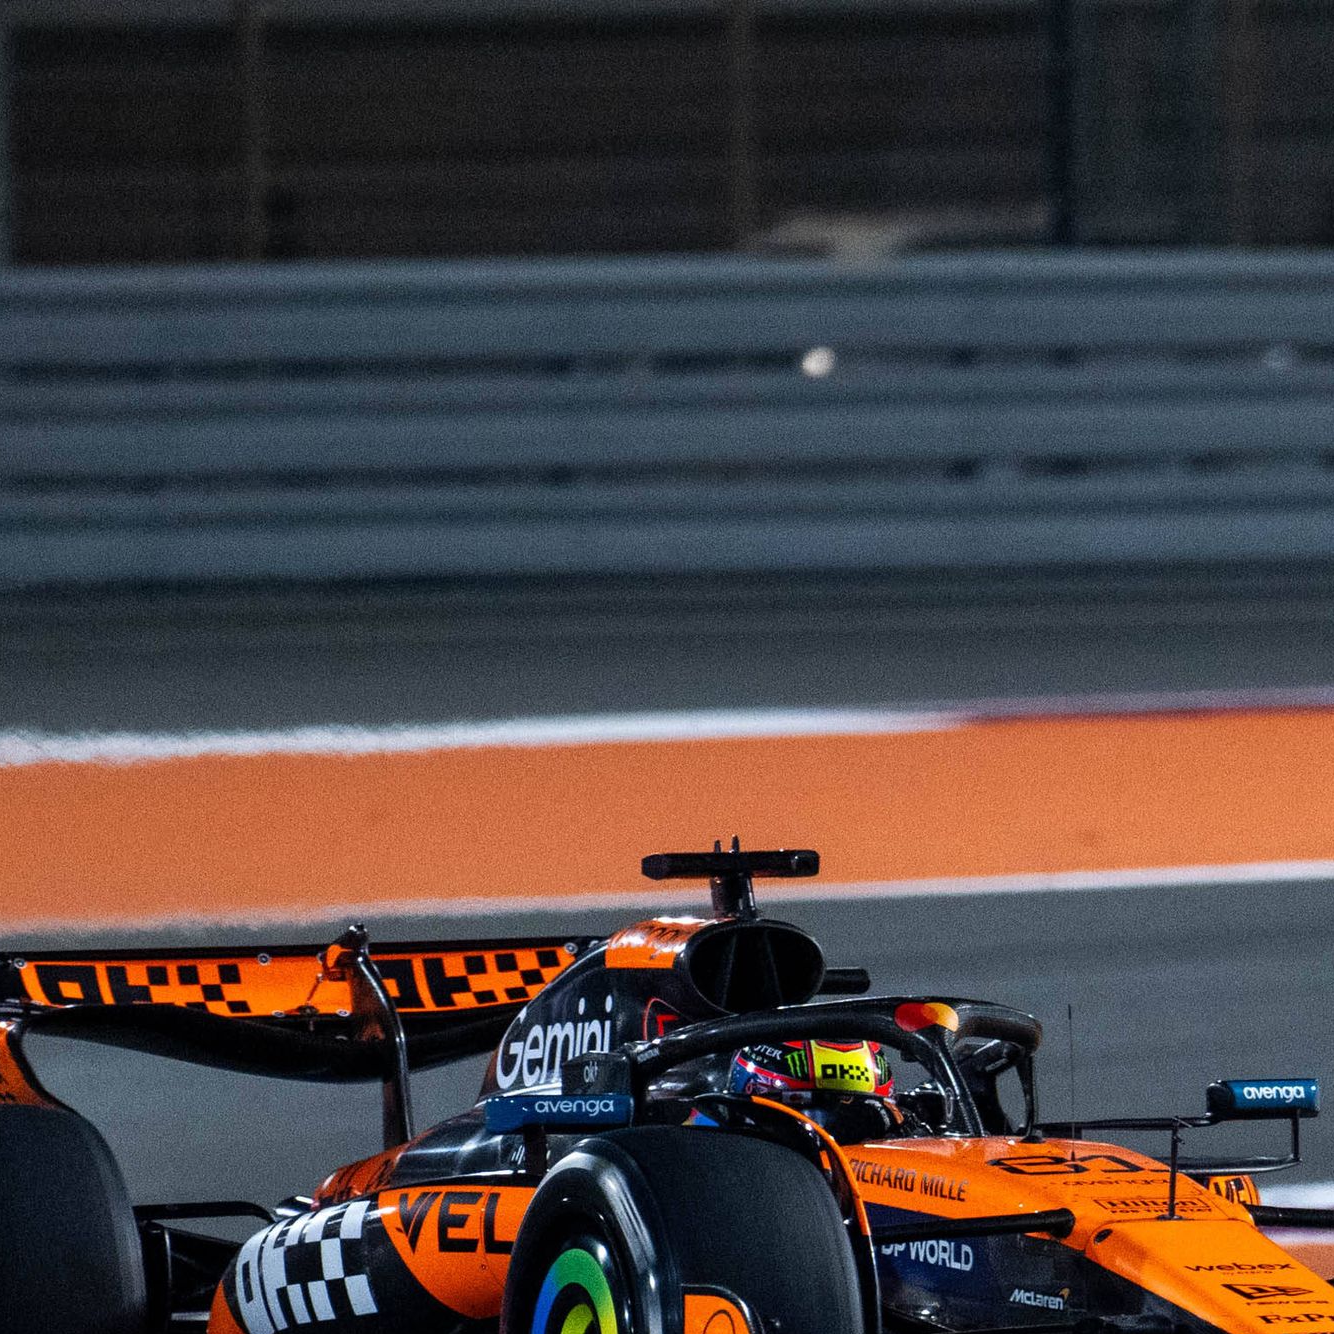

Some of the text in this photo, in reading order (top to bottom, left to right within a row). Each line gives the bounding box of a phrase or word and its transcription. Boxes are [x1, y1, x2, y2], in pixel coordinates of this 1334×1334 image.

[36, 964, 251, 1015] OKX
[496, 994, 614, 1090] Gemini
[821, 1064, 870, 1082] OKX
[1243, 1083, 1305, 1103] avenga
[534, 1098, 614, 1117] avenga
[850, 1158, 969, 1202] RICHARD MILLE
[1063, 1177, 1170, 1187] avenga
[909, 1239, 973, 1272] WORLD
[1183, 1262, 1296, 1272] webex
[1009, 1287, 1065, 1311] McLaren
